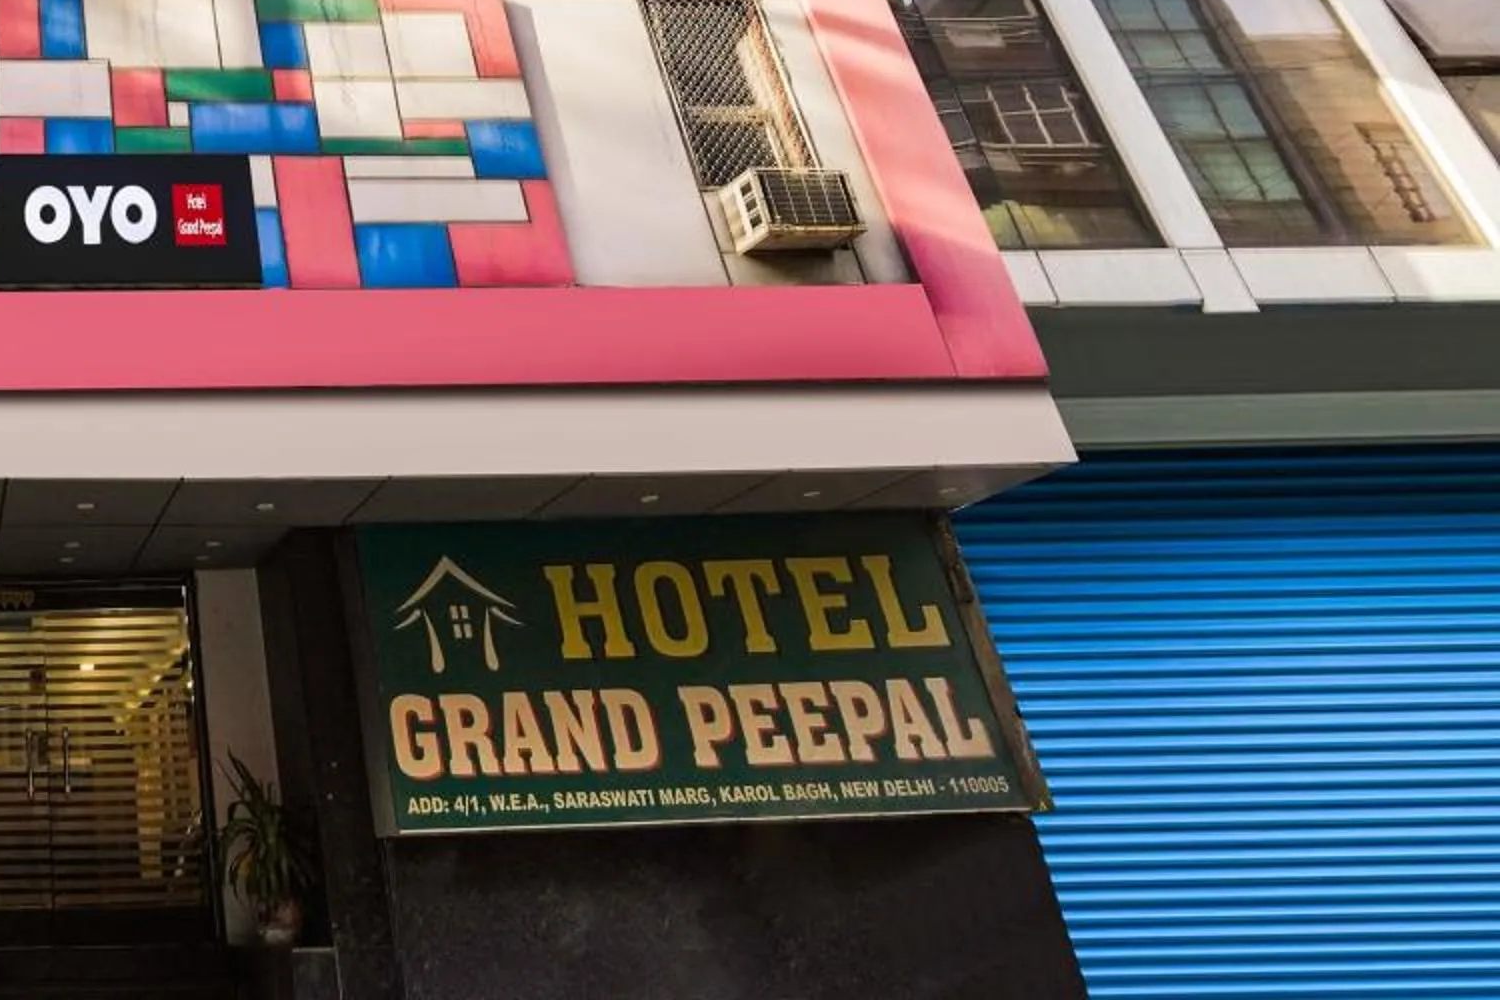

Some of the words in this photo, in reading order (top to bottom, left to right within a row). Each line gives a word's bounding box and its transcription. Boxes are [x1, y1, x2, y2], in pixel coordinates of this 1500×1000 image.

[23, 185, 158, 245] OYO
[542, 554, 952, 661] HOTEL
[389, 687, 660, 781] GRAND
[677, 676, 996, 770] PEEPAL
[407, 797, 450, 815] ADD:
[553, 788, 655, 811] SARASWATI
[658, 786, 717, 807] MARG,
[719, 784, 781, 804] KAROL
[782, 781, 839, 802] BAGH,
[840, 779, 881, 799] NEW
[883, 777, 937, 797] DELHI
[949, 775, 1010, 794] 110005
